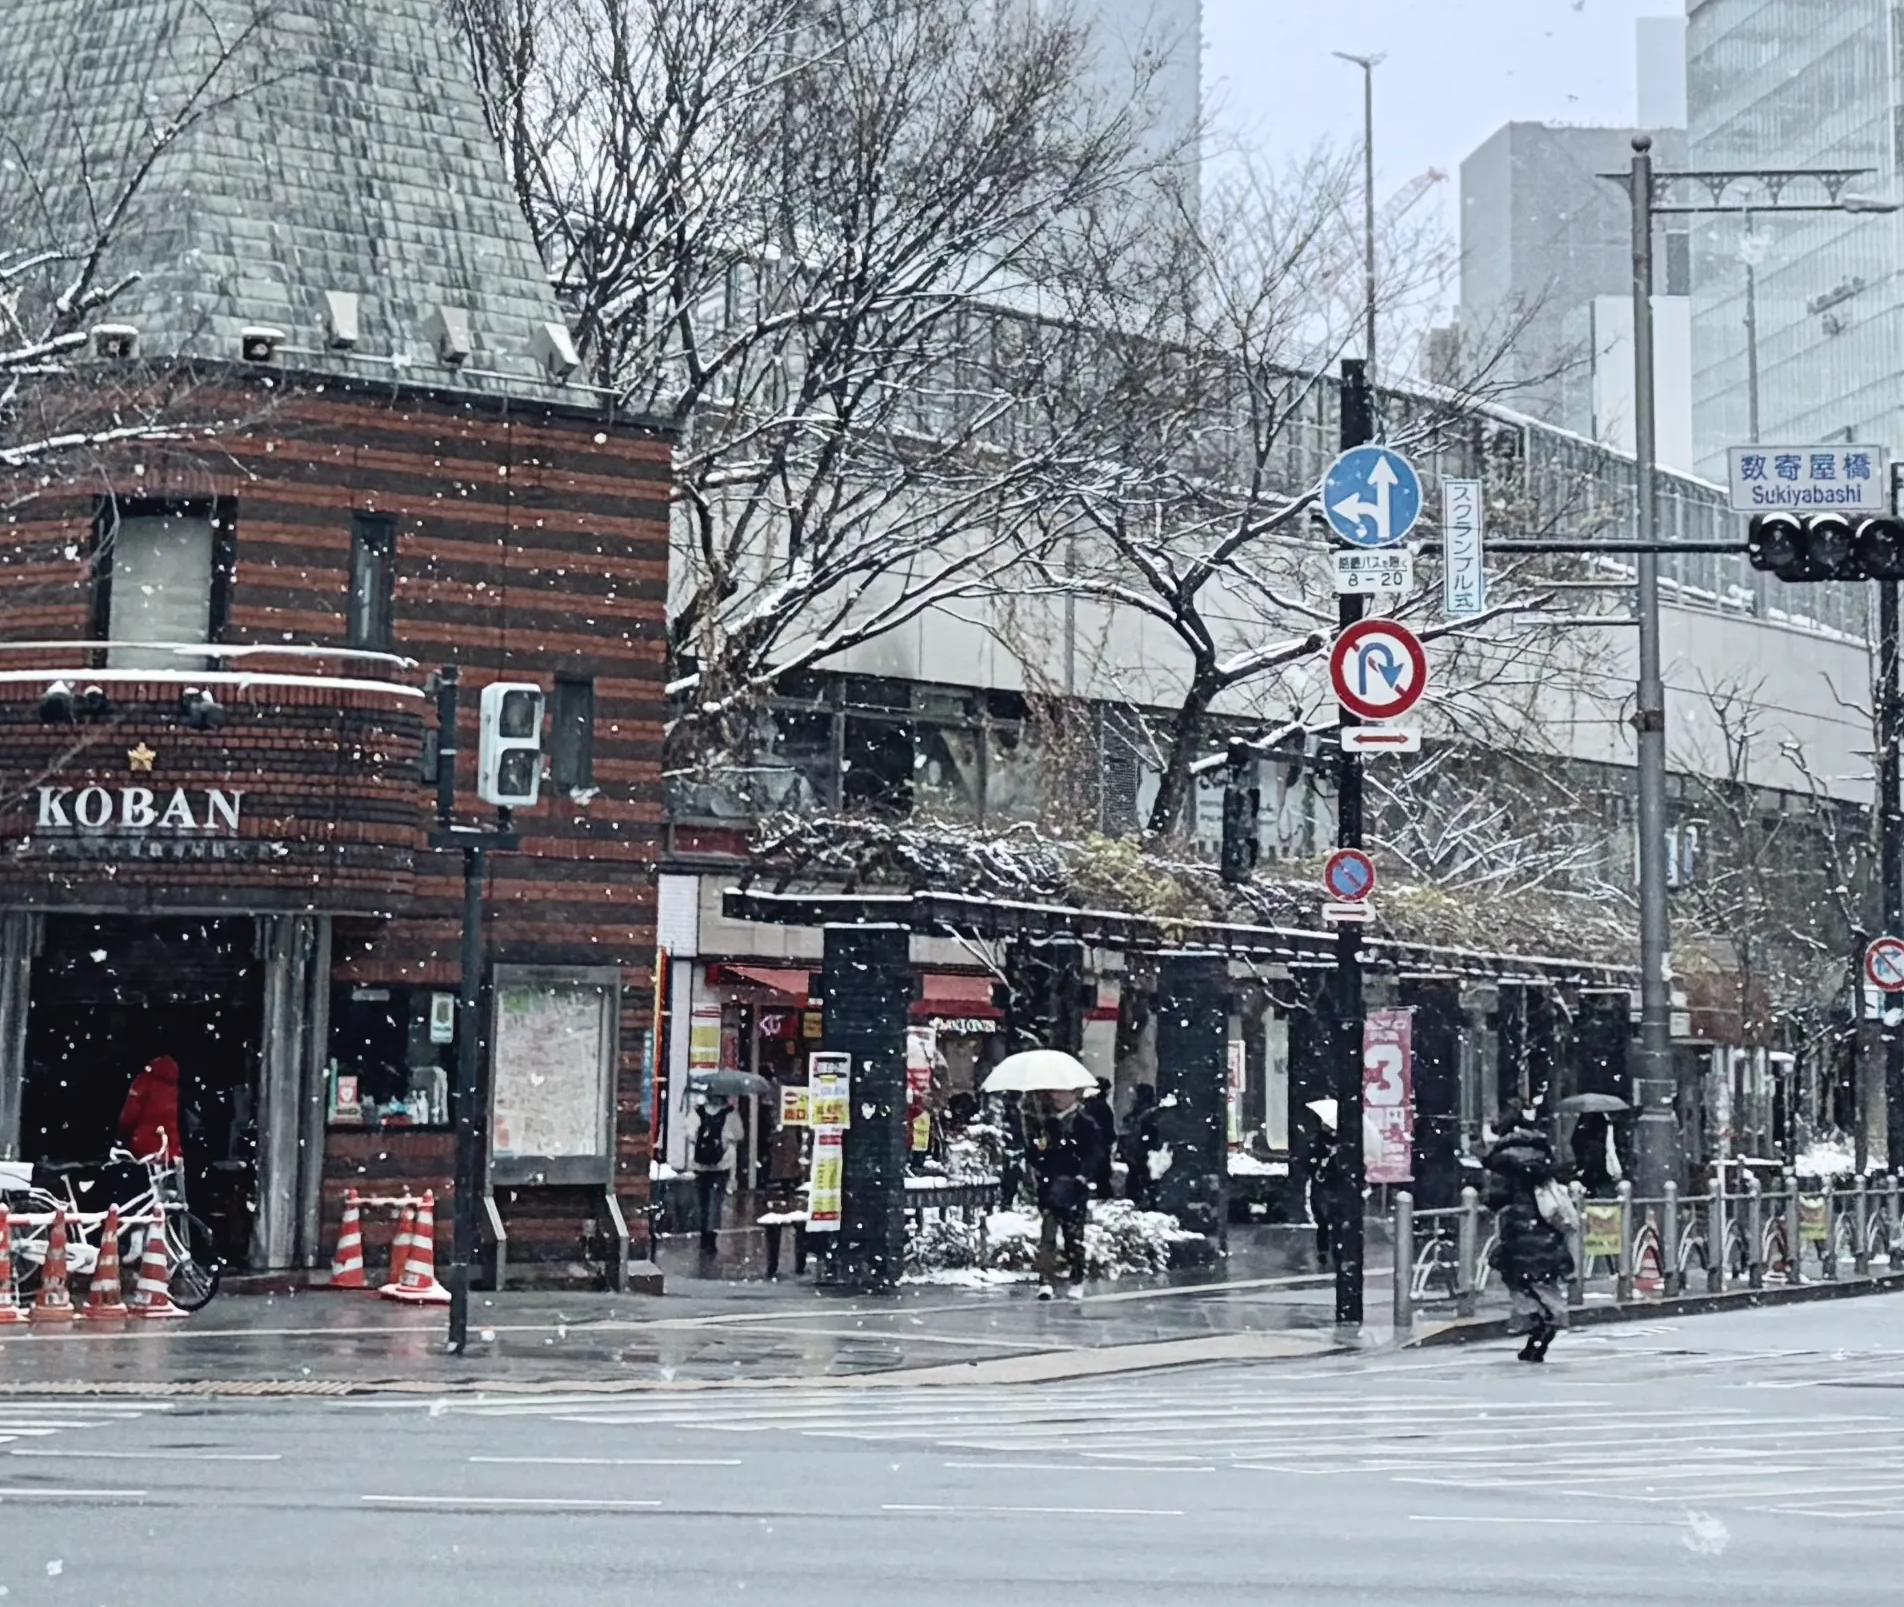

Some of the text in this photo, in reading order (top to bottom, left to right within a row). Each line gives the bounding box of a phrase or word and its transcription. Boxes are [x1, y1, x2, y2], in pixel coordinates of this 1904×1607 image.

[1741, 453, 1872, 481] 数寄屋橋
[1752, 484, 1862, 506] Sukiyabashi
[1452, 484, 1475, 609] スクランブル式
[35, 786, 245, 830] KOBAN
